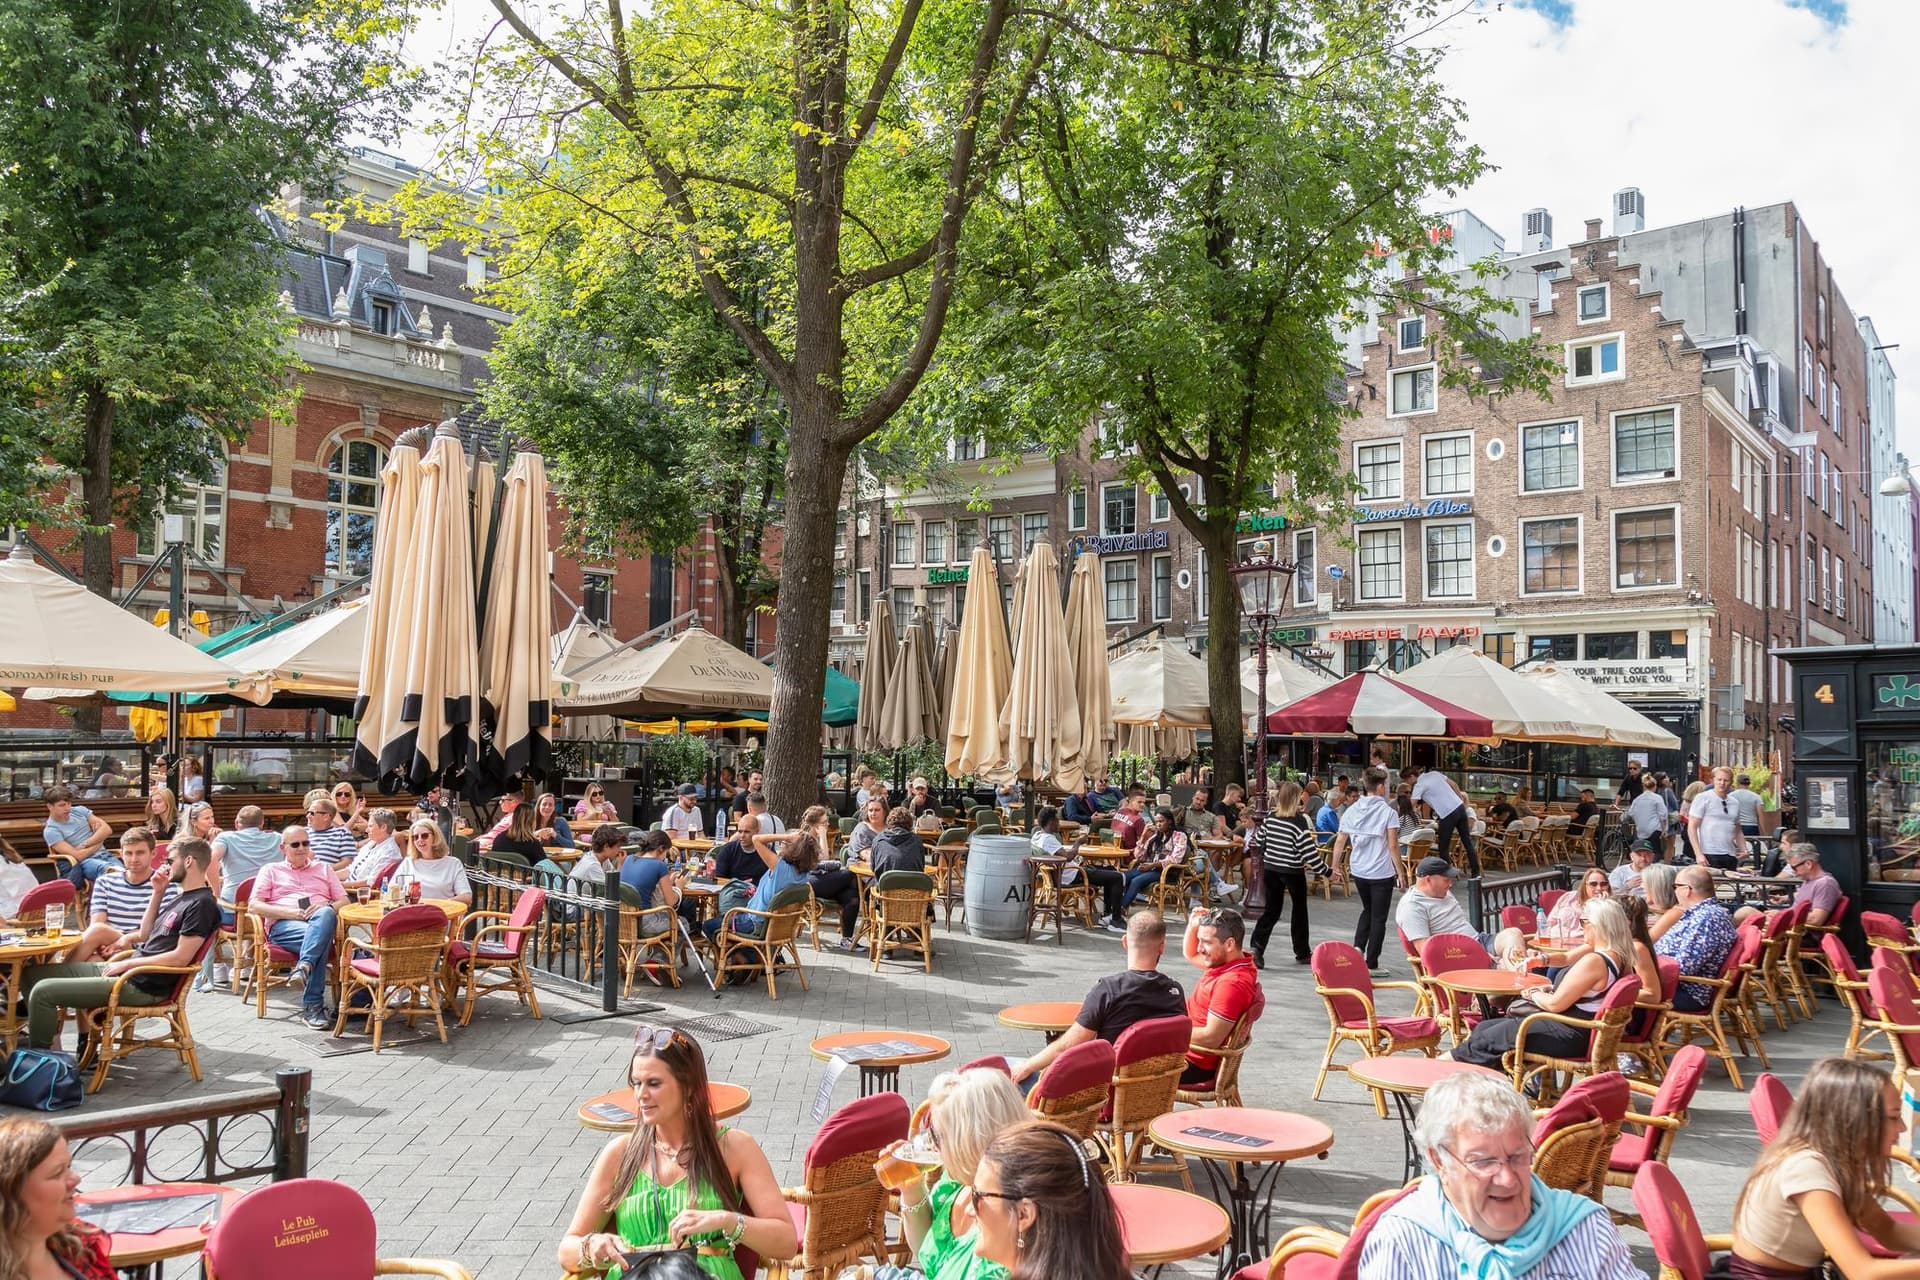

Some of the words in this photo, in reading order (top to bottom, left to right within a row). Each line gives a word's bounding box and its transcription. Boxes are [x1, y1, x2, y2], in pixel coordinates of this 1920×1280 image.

[1354, 503, 1421, 525] Bavaria
[1426, 498, 1471, 517] Bier
[1087, 527, 1168, 555] Bavaria
[927, 567, 970, 584] Heinek
[1328, 629, 1374, 640] CAFE
[1376, 628, 1401, 639] DE
[1417, 626, 1481, 639] AAD
[91, 674, 115, 683] PUB
[1573, 667, 1596, 675] YOUR
[1602, 667, 1624, 675] TRUE
[1629, 666, 1664, 675] COLORS
[1591, 676, 1611, 684] WHY
[1624, 675, 1647, 683] LOVE
[1652, 675, 1672, 683] YOU
[1814, 684, 1835, 704] 4
[1890, 748, 1920, 765] Ho
[282, 1219, 295, 1231] Le
[296, 1216, 316, 1228] Pub
[274, 1228, 329, 1248] Leidseplein
